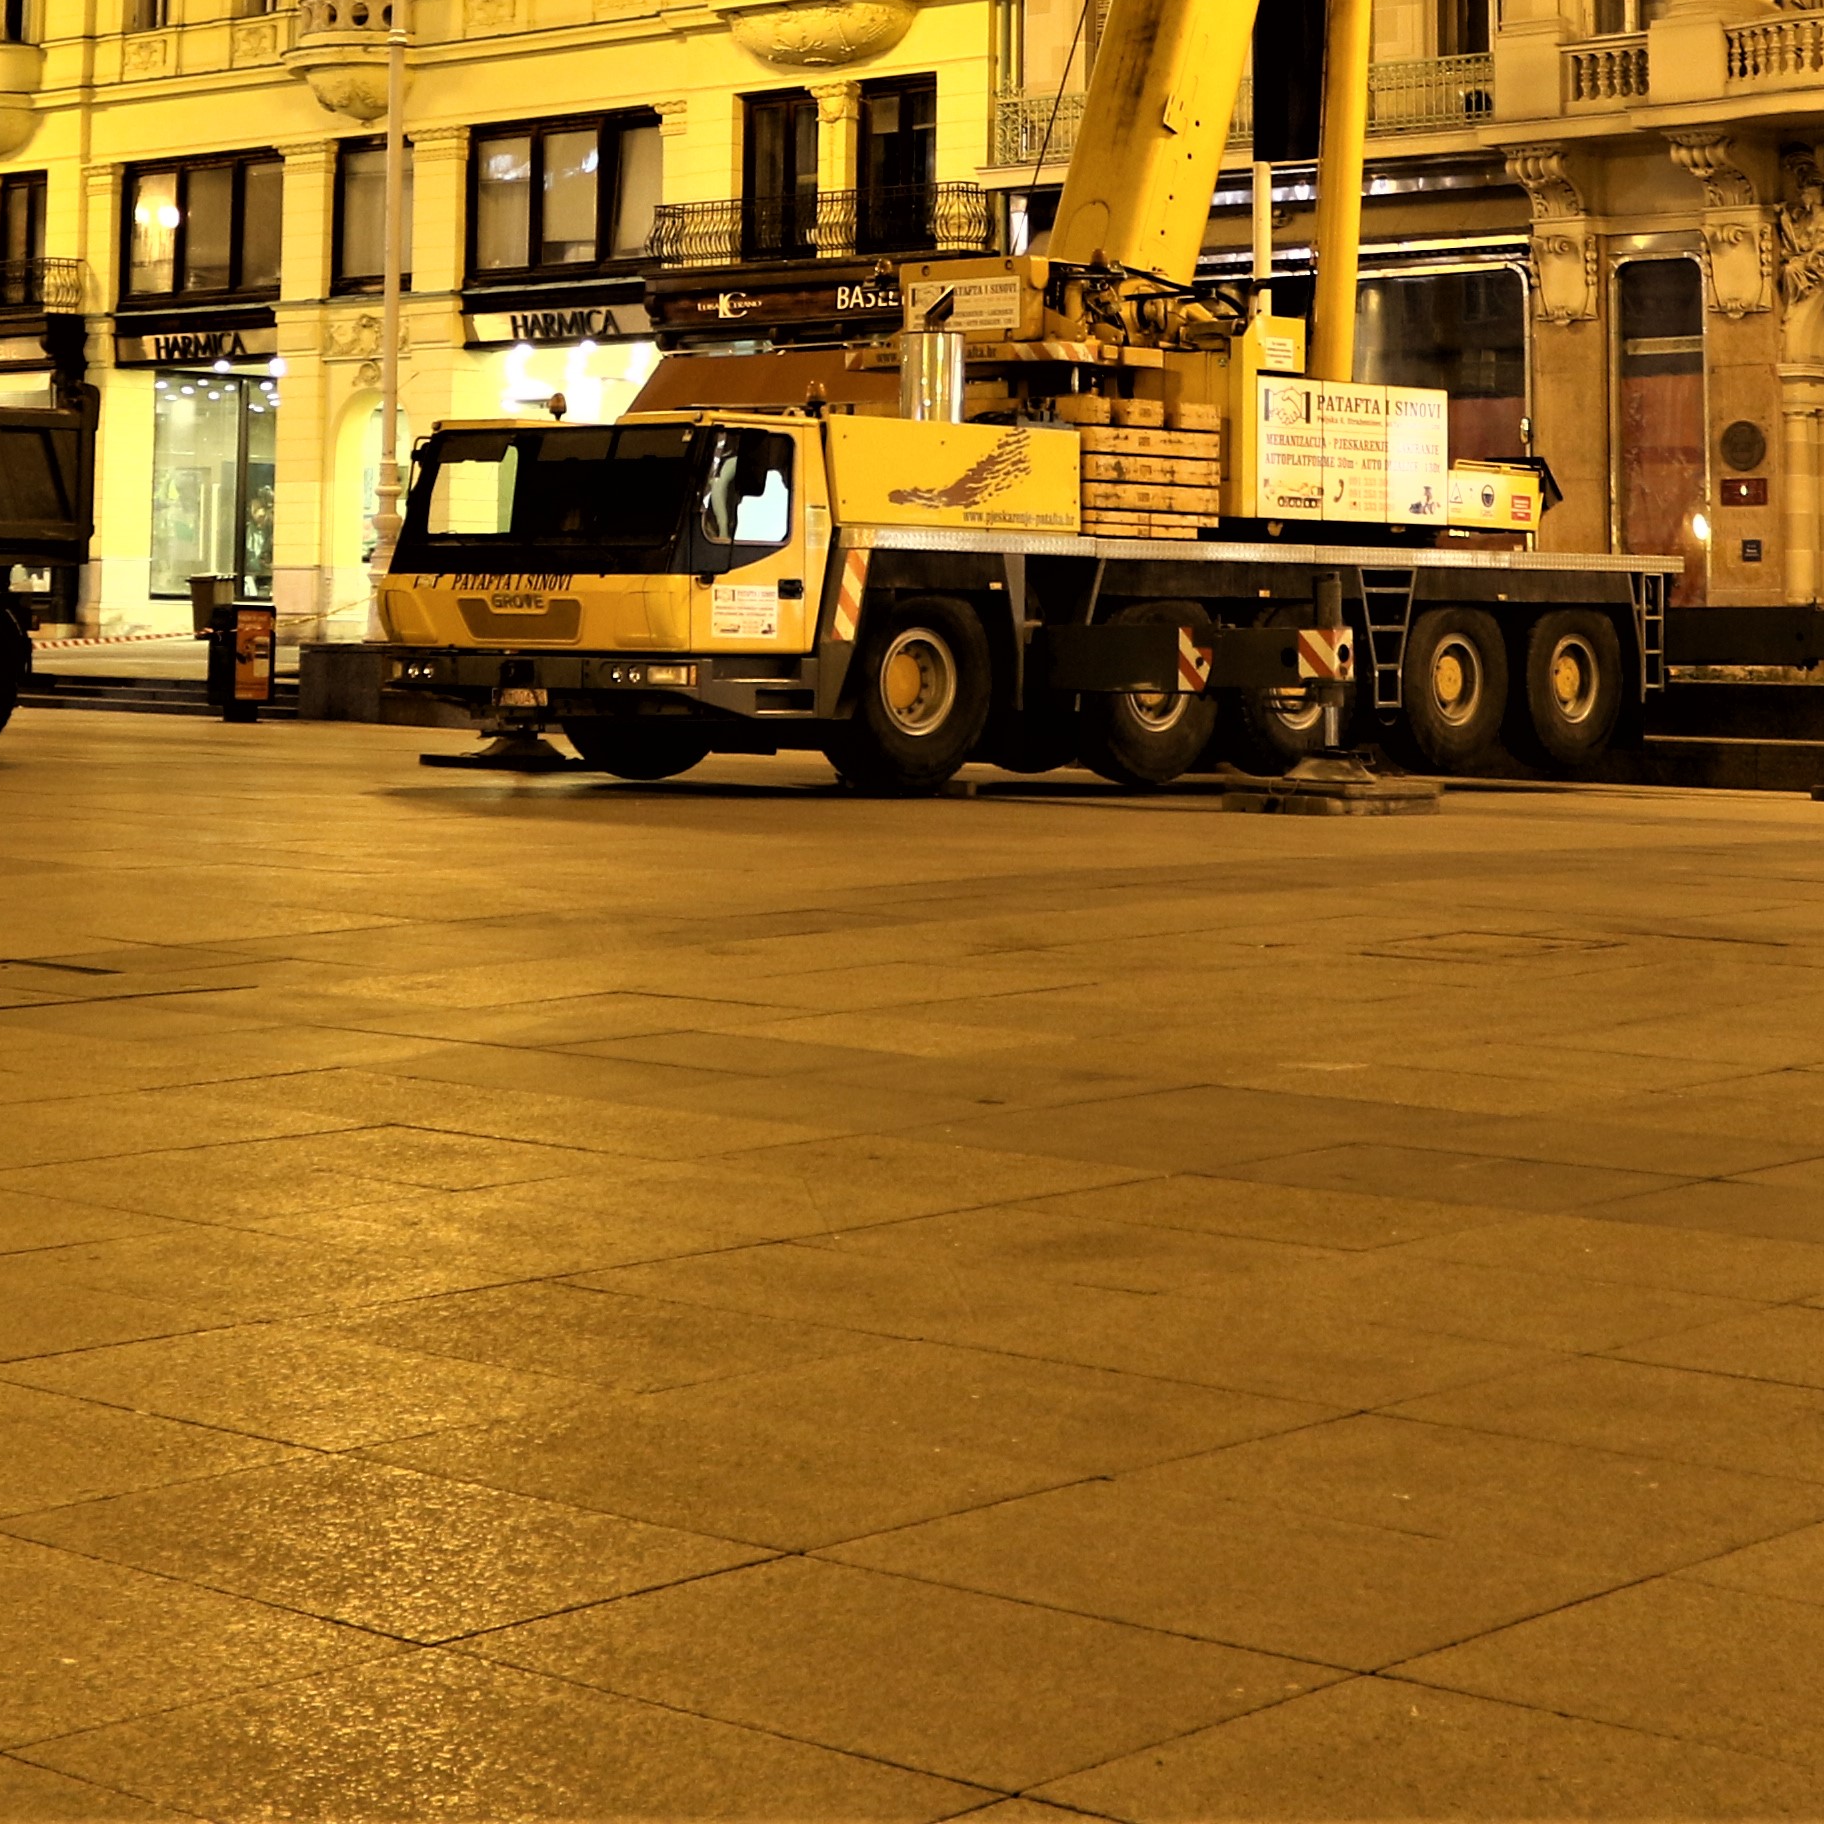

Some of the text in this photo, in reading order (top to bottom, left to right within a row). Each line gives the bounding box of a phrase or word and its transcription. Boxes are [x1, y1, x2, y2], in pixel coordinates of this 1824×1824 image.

[509, 309, 621, 339] HARMICA
[155, 331, 248, 360] HARMICA
[1317, 395, 1442, 418] PATAFTA I SINOVI
[1266, 433, 1327, 449] MEHANIZACIJA
[1333, 437, 1389, 453] PJESKARENJE
[1361, 458, 1383, 471] AUTO
[451, 574, 574, 591] PATAFTA I SINOVI
[491, 593, 545, 609] GROVE
